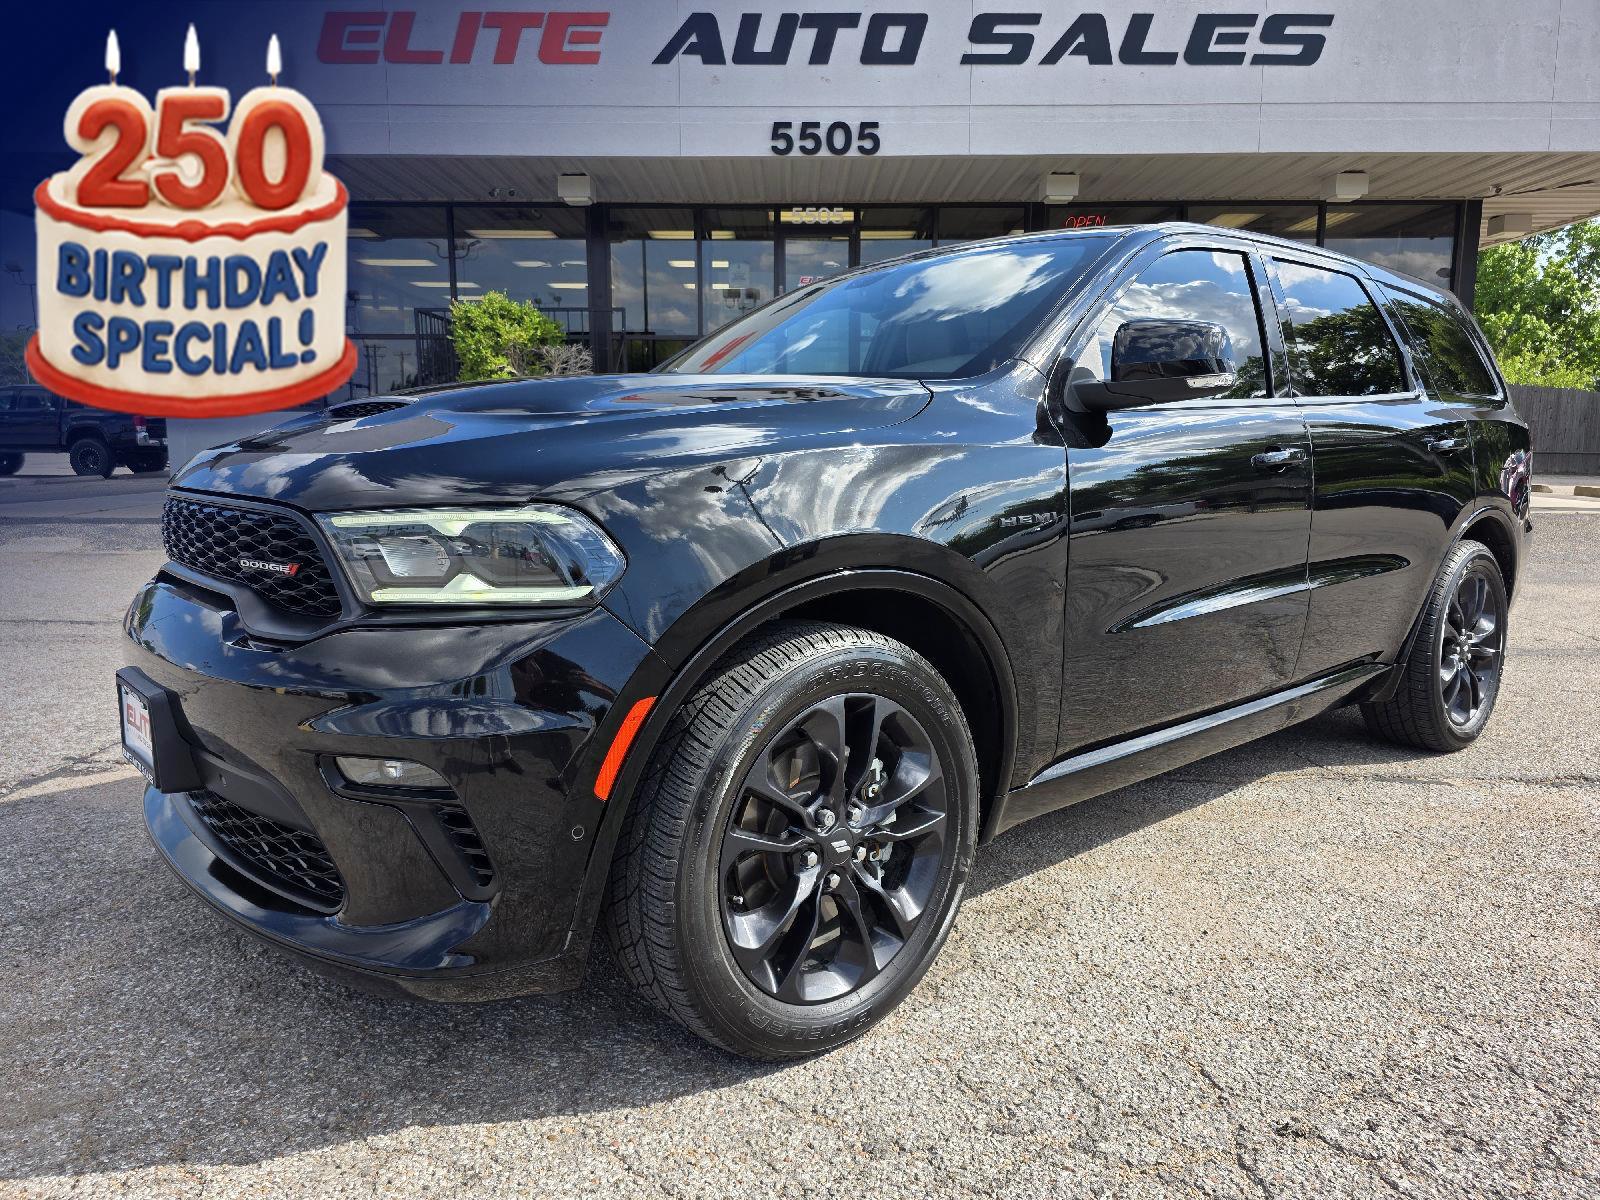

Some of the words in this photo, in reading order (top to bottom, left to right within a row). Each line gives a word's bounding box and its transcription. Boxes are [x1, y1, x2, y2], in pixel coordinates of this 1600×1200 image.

[316, 12, 610, 64] ELITE
[651, 12, 929, 65] AUTO
[959, 13, 1335, 66] SALES
[771, 121, 881, 155] 5505
[791, 207, 844, 225] 5505
[1065, 215, 1106, 229] OPEN
[999, 511, 1058, 528] HEMI
[240, 559, 292, 574] DODGE
[126, 702, 151, 738] ELIT
